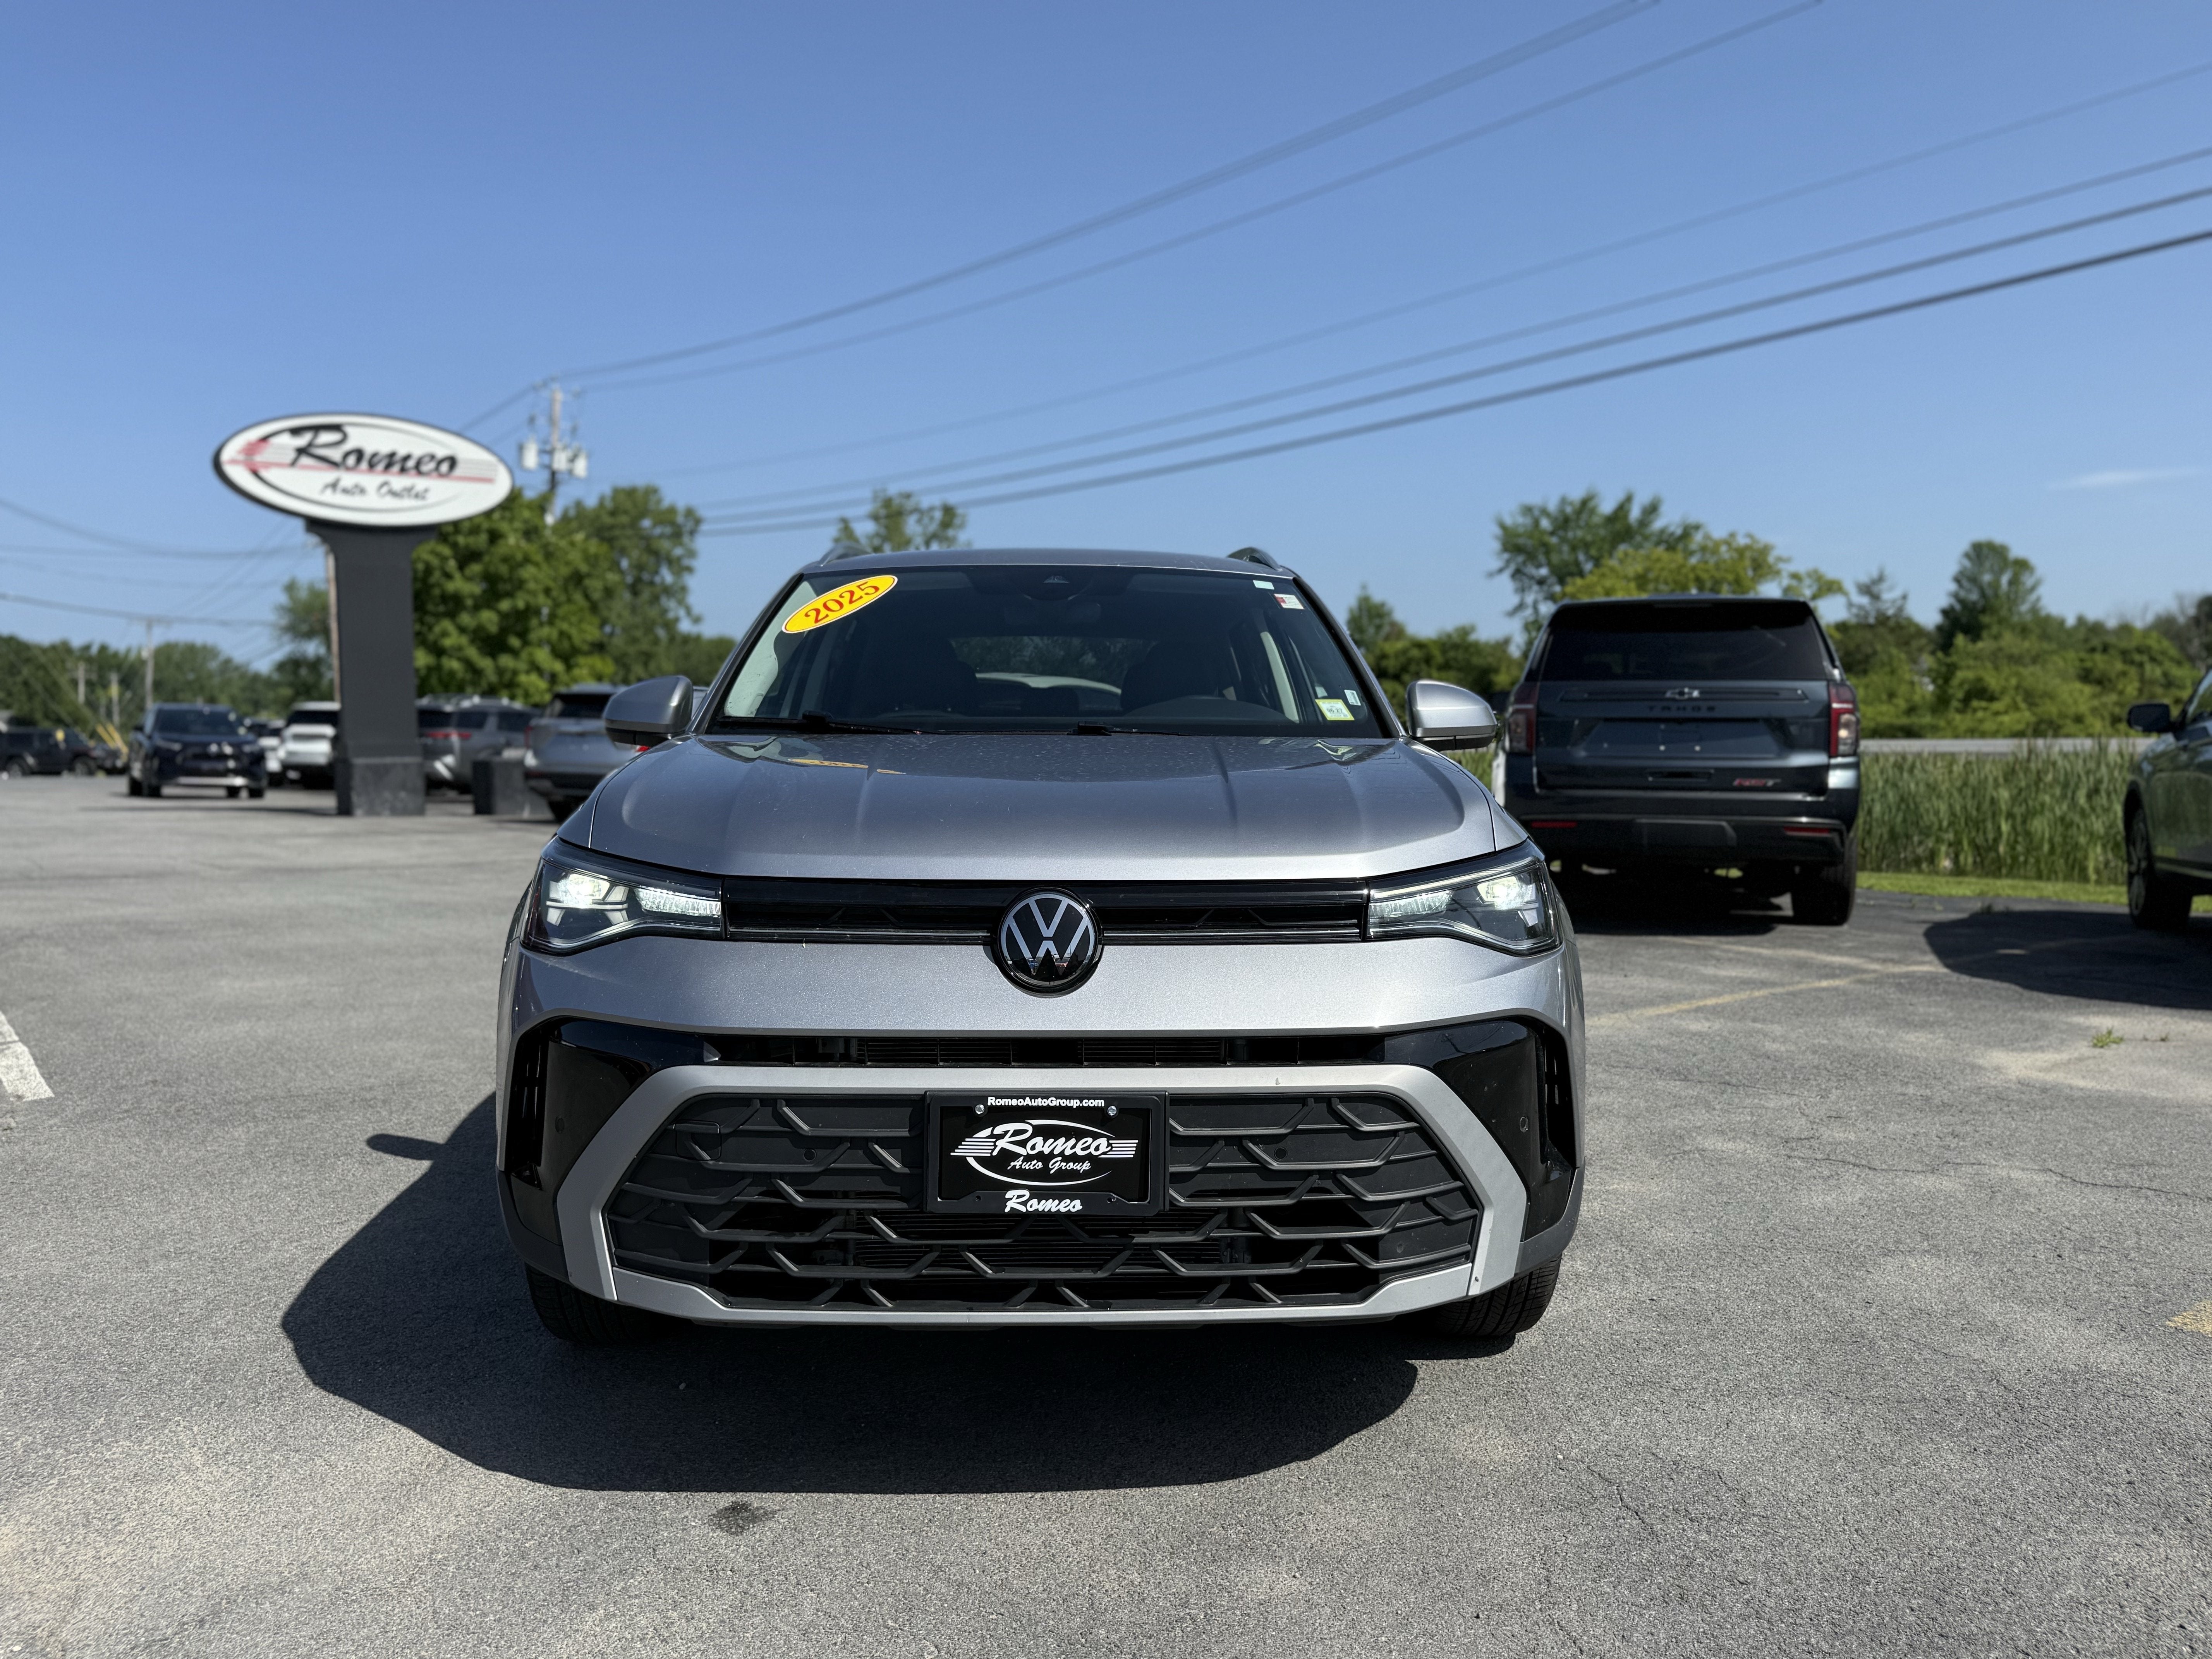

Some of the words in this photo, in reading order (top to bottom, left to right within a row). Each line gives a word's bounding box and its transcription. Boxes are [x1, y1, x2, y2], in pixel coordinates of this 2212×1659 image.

[288, 424, 457, 477] Romeo
[320, 476, 367, 496] Auto
[804, 581, 879, 624] 2025
[988, 1097, 1105, 1108] RomeoAutoGroup.com
[992, 1122, 1111, 1156] Romeo
[1007, 1156, 1043, 1170] Auto
[1049, 1156, 1092, 1174] Group
[1005, 1188, 1083, 1212] Romeo
